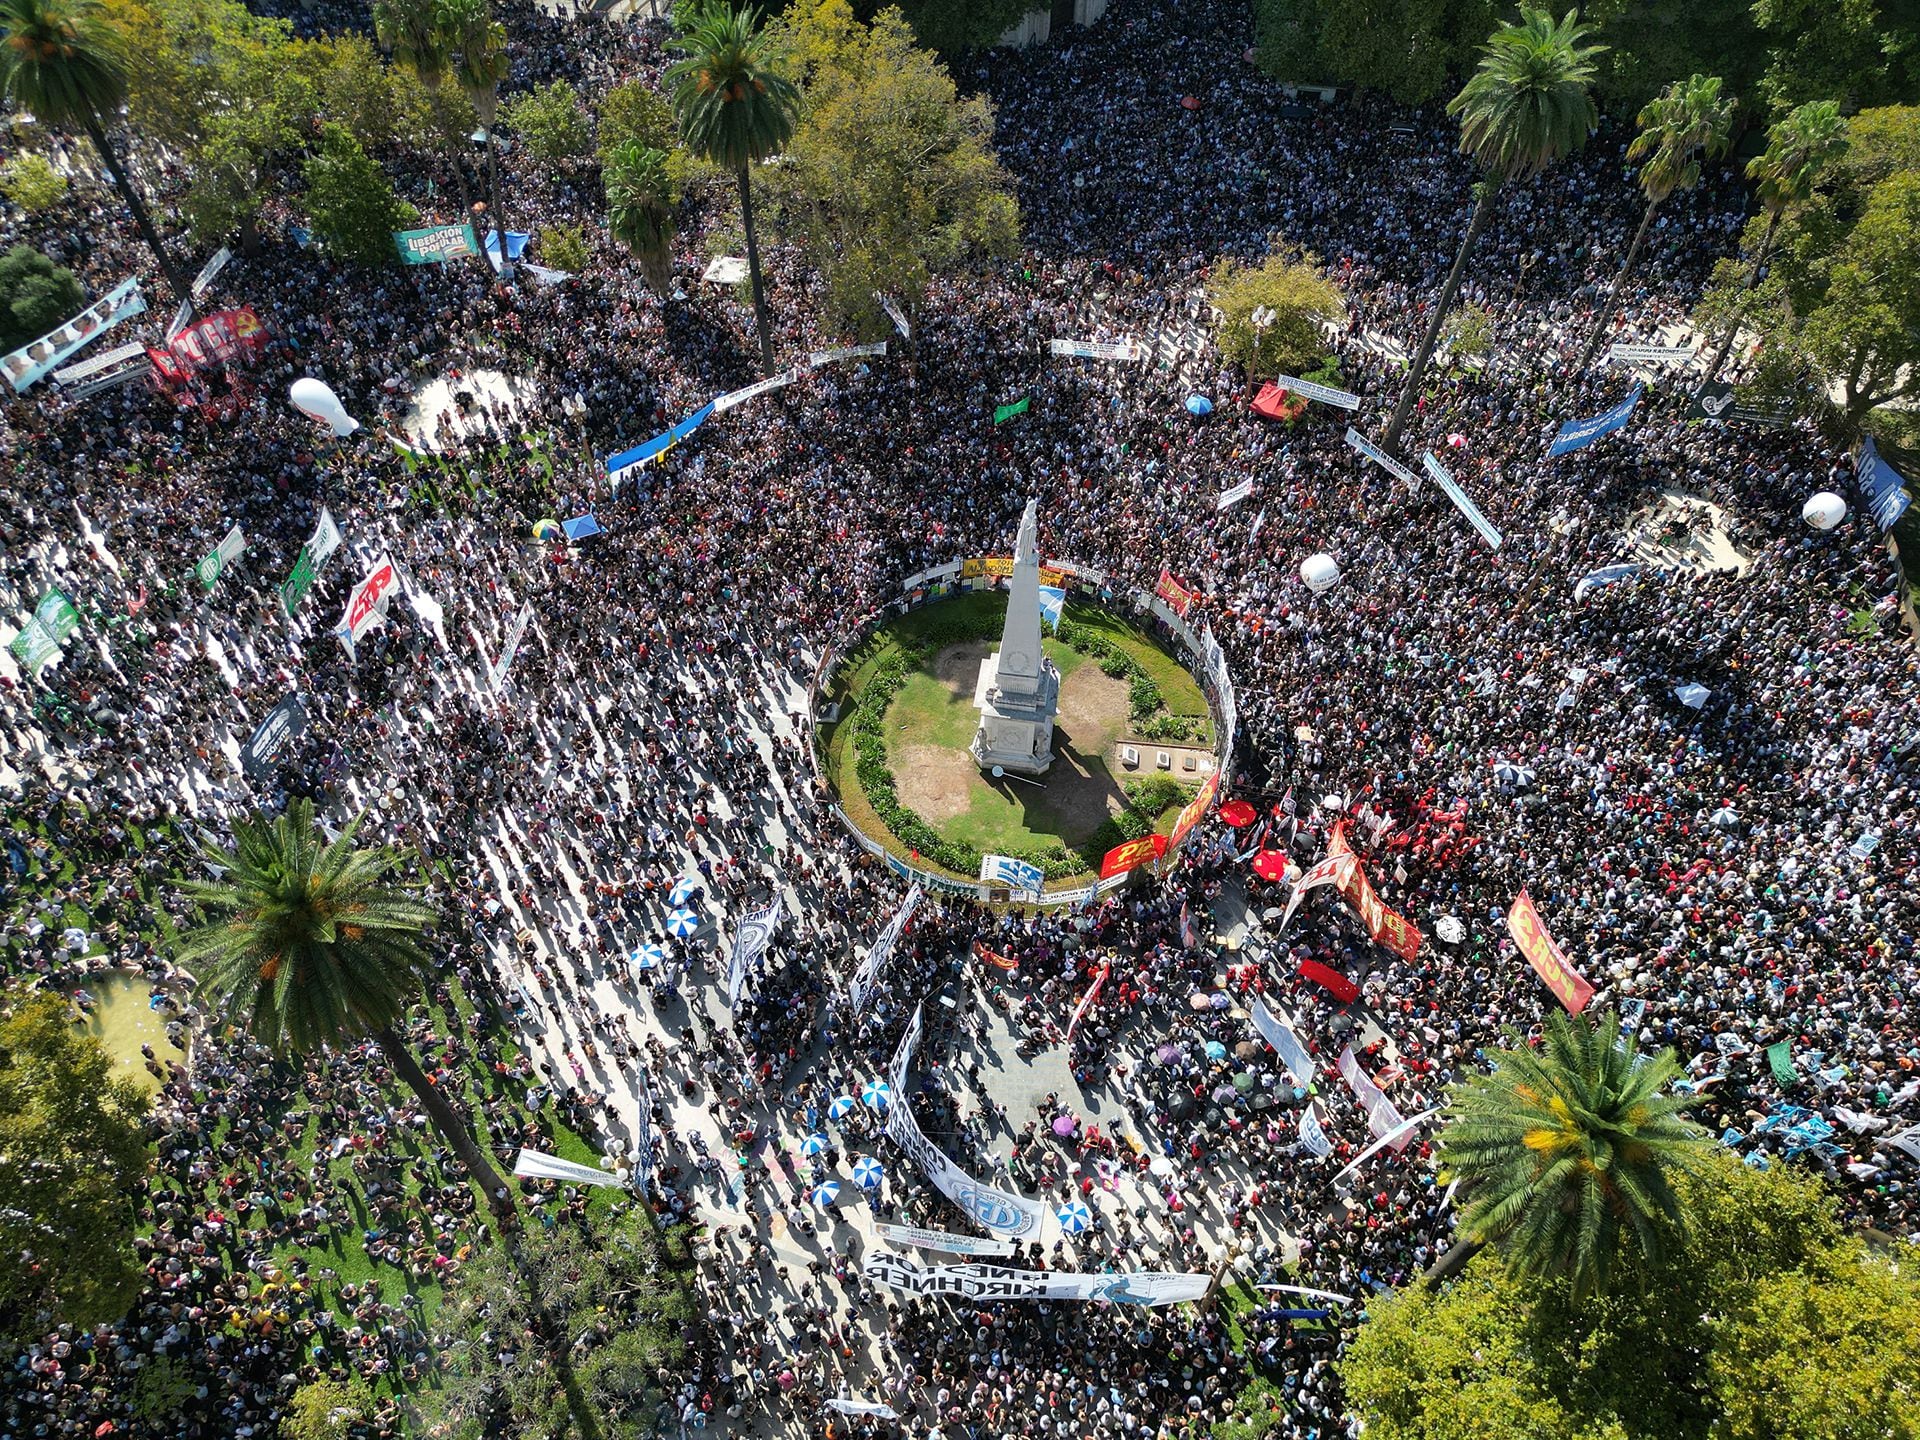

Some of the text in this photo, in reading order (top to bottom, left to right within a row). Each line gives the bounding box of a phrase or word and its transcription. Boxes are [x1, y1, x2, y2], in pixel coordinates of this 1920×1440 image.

[408, 227, 463, 252] LIBERACION
[1280, 376, 1317, 391] JUVENTUDES
[1325, 389, 1358, 402] ARGENTINA
[911, 869, 927, 883] DE
[929, 877, 980, 896] FRENTE
